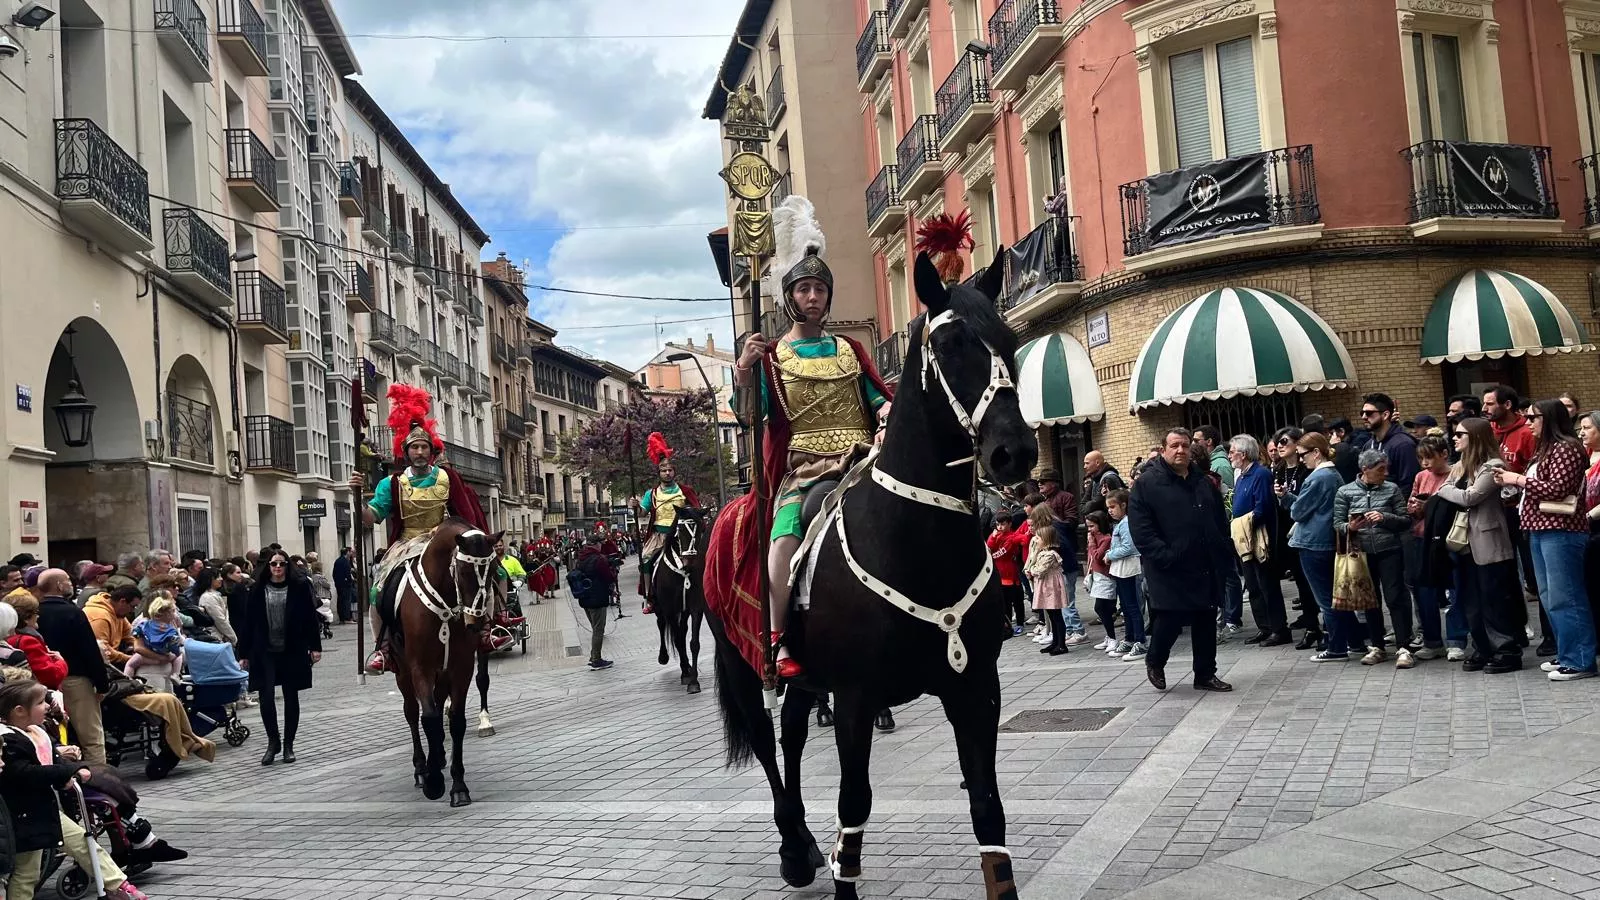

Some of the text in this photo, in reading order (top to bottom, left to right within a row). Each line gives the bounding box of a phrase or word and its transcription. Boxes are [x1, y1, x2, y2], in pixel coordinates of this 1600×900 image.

[730, 164, 771, 189] SPQR
[1160, 211, 1260, 236] SEMANA SANTA
[1091, 332, 1106, 342] ALTO
[299, 502, 324, 510] embou
